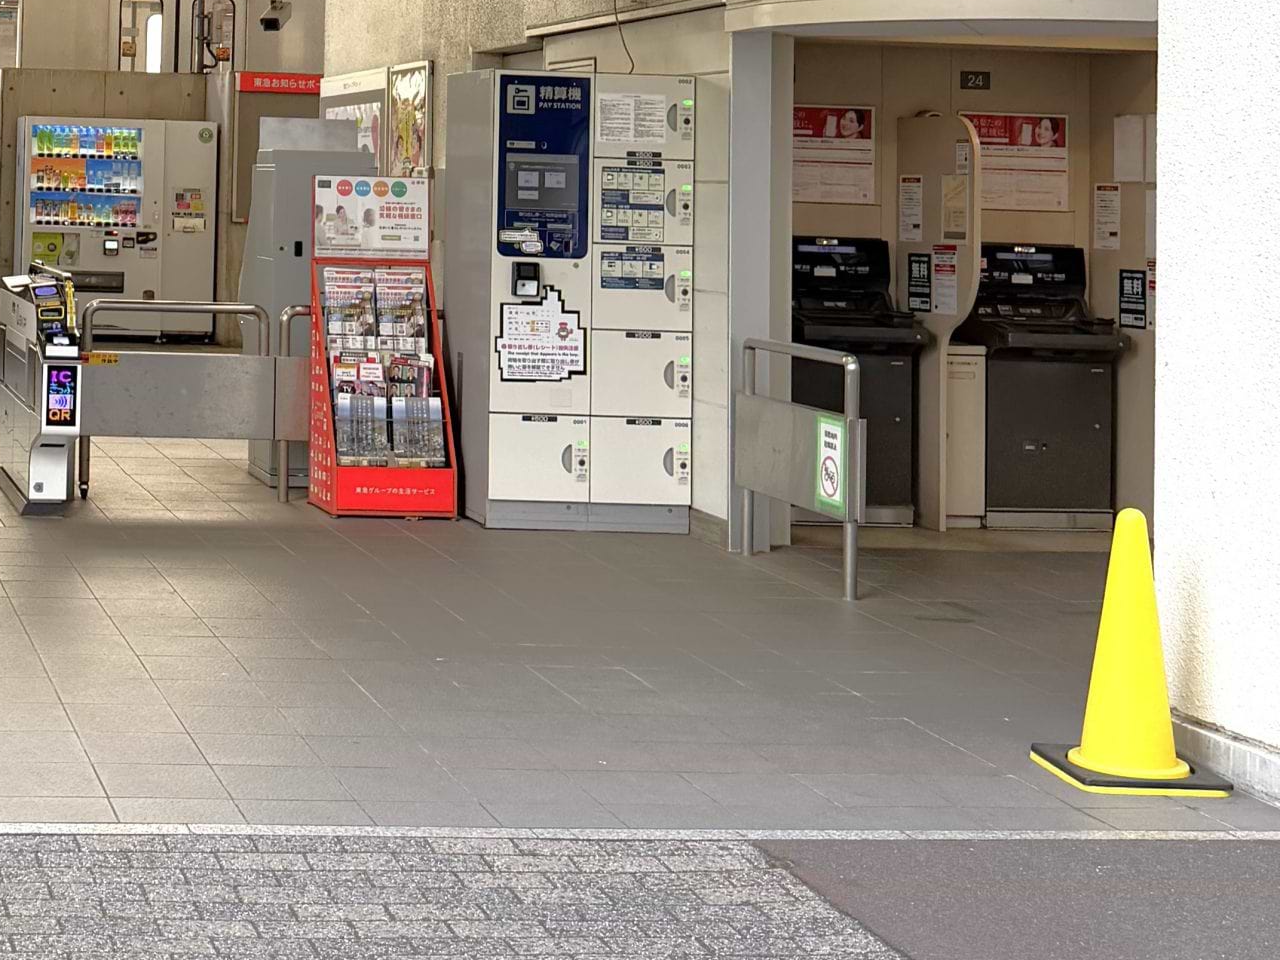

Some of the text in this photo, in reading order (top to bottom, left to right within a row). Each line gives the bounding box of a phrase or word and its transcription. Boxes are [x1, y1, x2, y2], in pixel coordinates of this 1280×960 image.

[967, 74, 985, 88] 24
[539, 85, 582, 101] 精算機
[538, 101, 582, 110] PAY STATION
[51, 370, 72, 382] IC
[48, 409, 71, 421] QR
